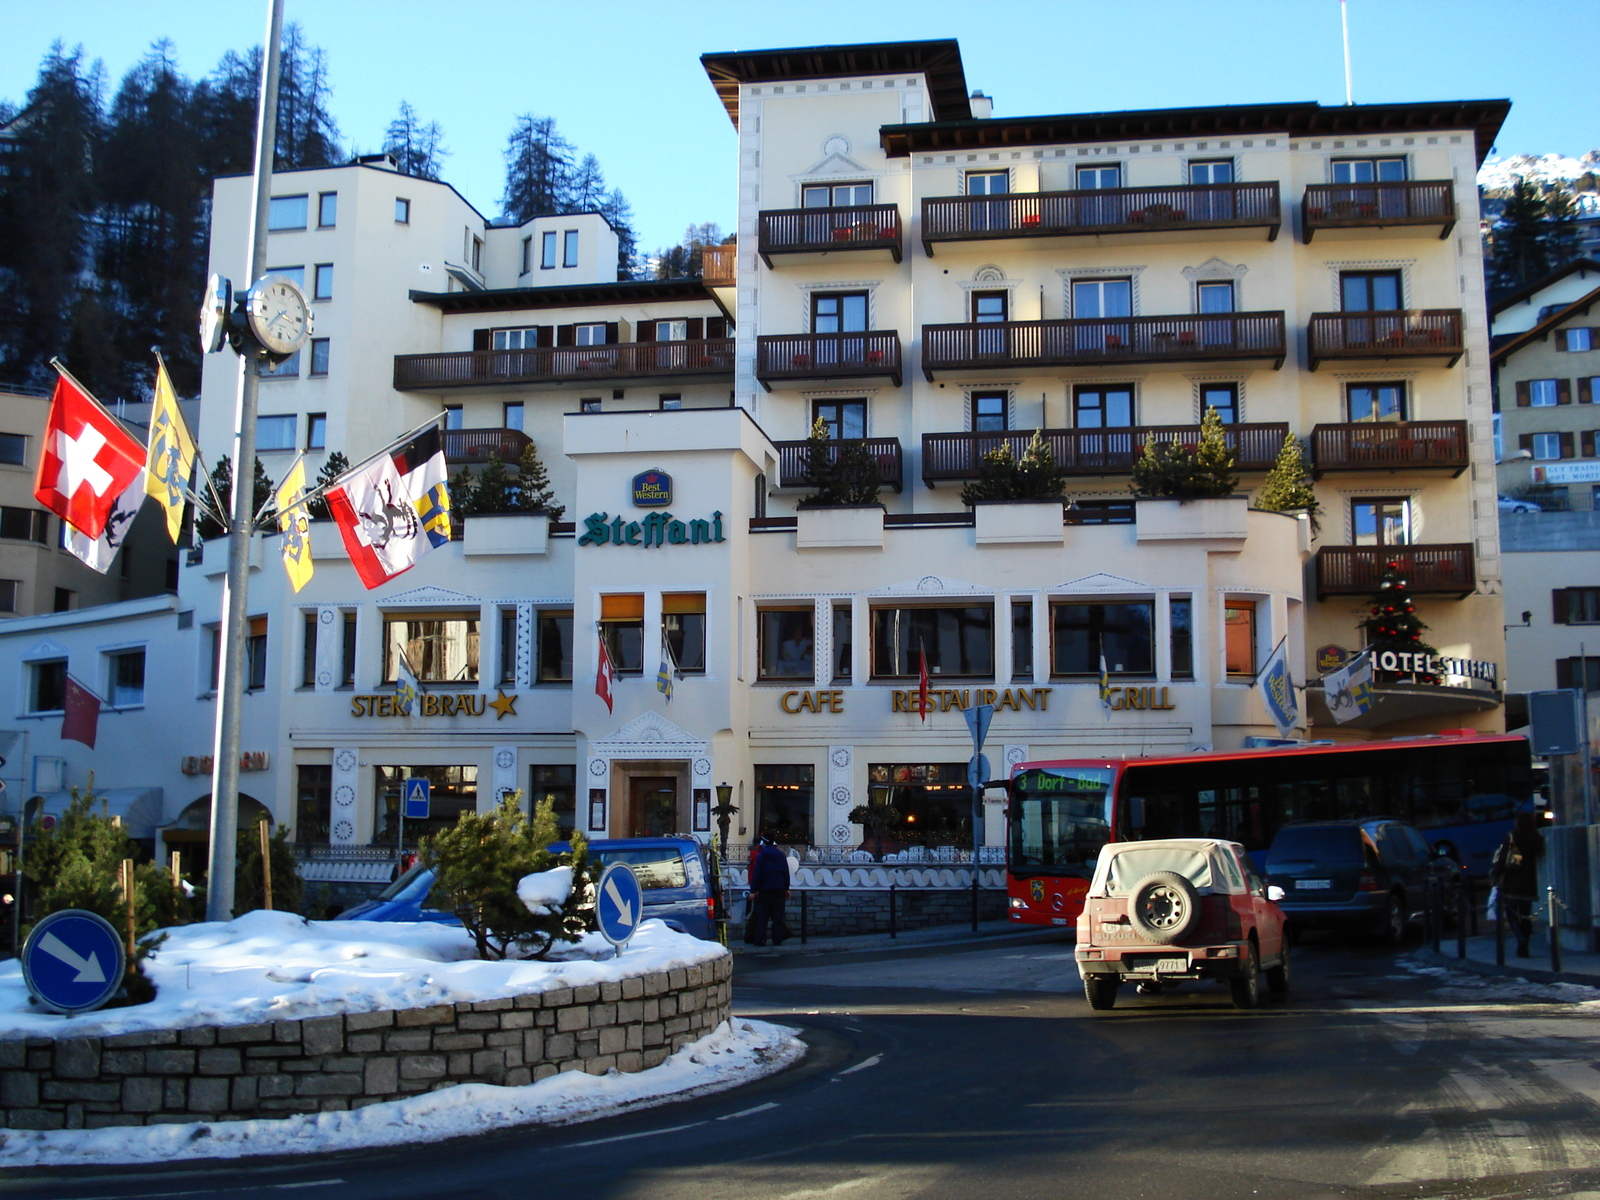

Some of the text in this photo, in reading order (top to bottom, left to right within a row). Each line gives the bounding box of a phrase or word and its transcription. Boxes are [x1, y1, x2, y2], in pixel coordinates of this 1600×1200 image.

[635, 491, 669, 500] Western
[642, 483, 660, 492] Best
[578, 510, 726, 548] Steffani
[1325, 654, 1340, 662] Best
[1369, 650, 1437, 674] HOTEL
[351, 694, 486, 717] STERBRÄU
[781, 690, 843, 714] CAFE
[891, 687, 1053, 713] RESTAURANT
[1107, 686, 1176, 710] GRILL
[1020, 774, 1027, 791] 3
[1078, 774, 1101, 790] Bad
[1095, 933, 1137, 941] SUZUKI
